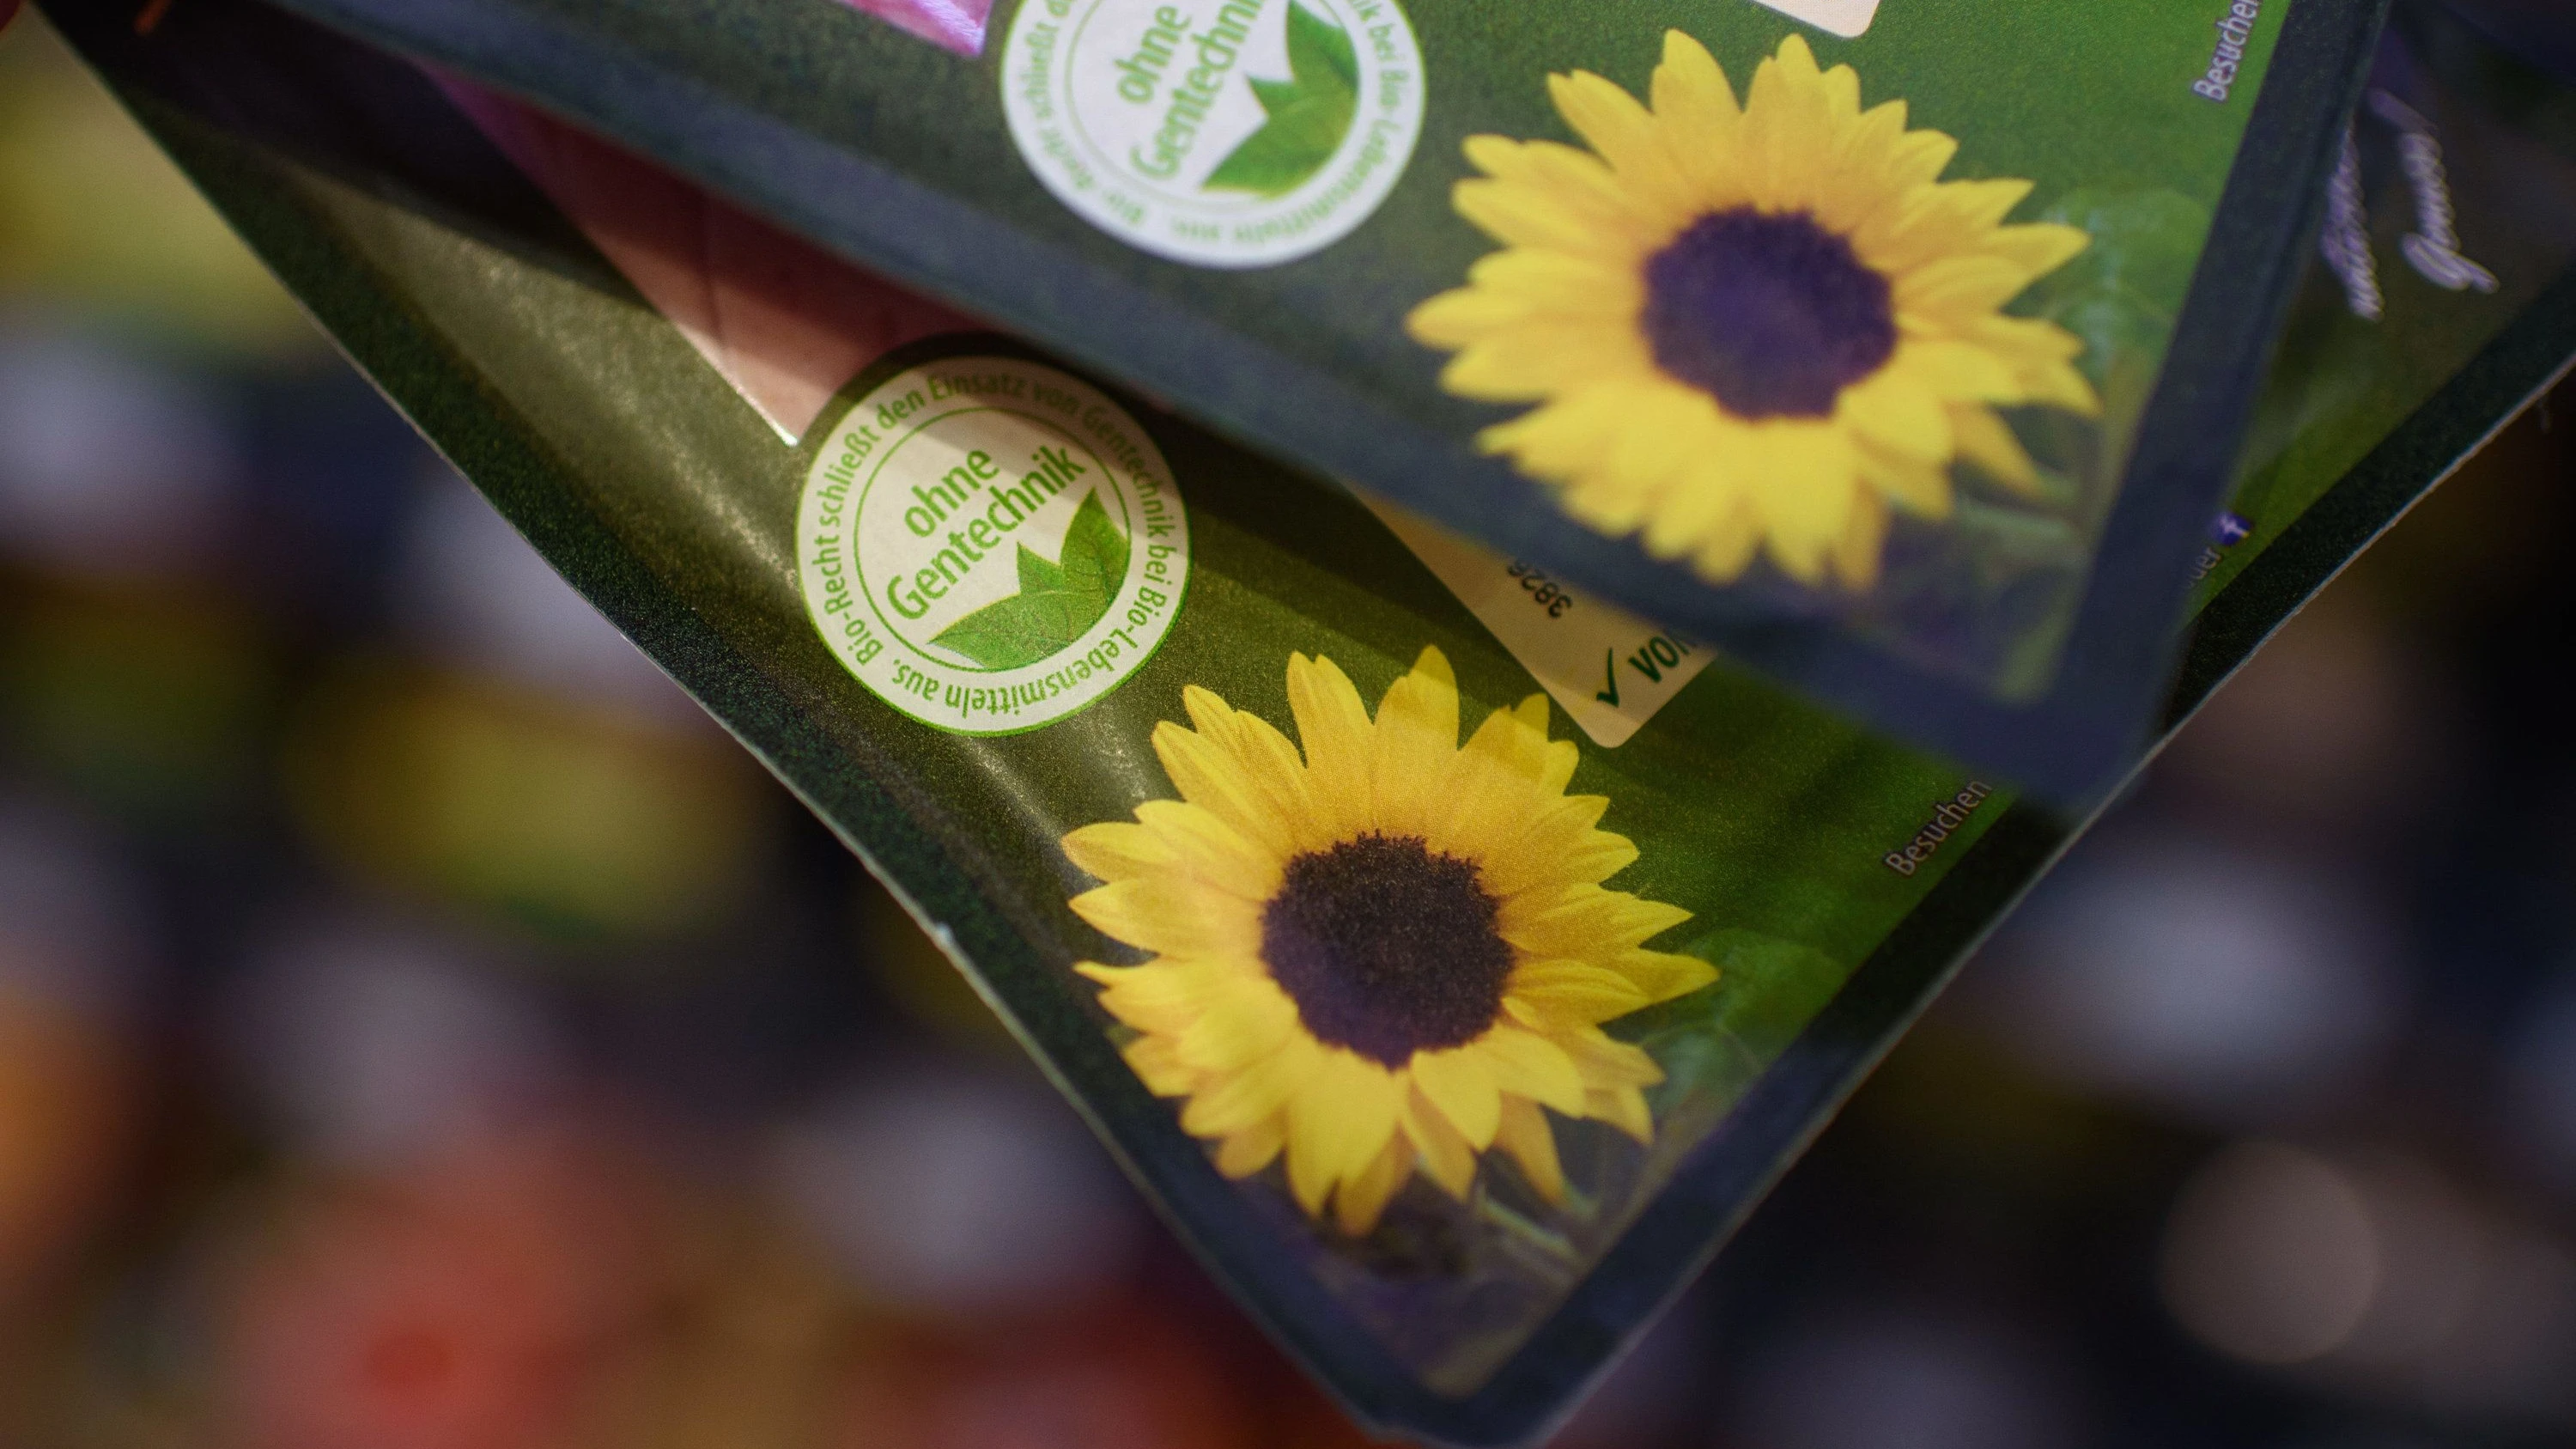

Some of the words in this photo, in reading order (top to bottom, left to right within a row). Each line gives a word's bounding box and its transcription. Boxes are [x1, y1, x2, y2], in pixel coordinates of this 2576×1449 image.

[1114, 5, 1191, 105] ohne
[876, 388, 927, 430] den
[926, 372, 1024, 402] Einsatz
[1032, 381, 1083, 414] von
[817, 423, 882, 528] schließt
[904, 449, 1000, 538] ohne
[1081, 404, 1176, 539] Gentechnik
[887, 445, 1087, 620] Gentechnik
[1144, 544, 1176, 590] bei
[811, 533, 884, 667] Bio-Recht
[892, 658, 939, 702] aus.
[945, 585, 1170, 719] Bio-Lebensmitteln
[1885, 779, 1993, 878] Besuchen
